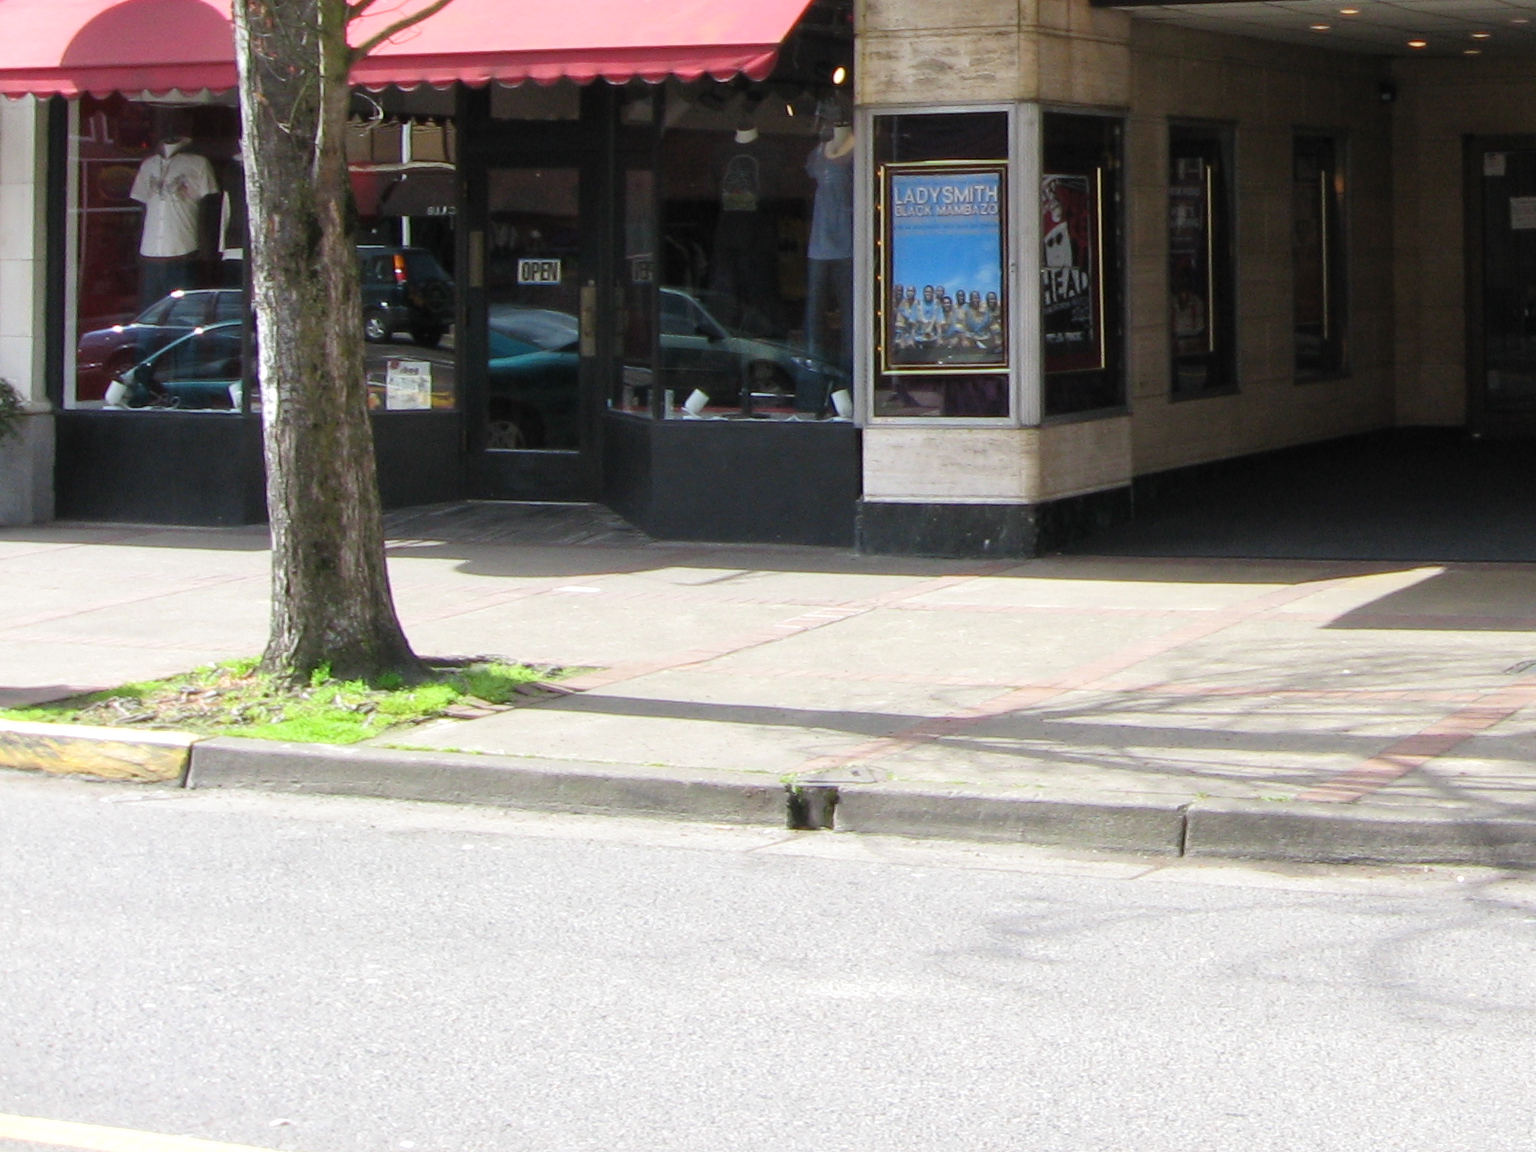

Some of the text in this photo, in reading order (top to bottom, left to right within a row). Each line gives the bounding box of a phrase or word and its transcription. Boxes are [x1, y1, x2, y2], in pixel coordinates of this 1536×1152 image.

[894, 185, 998, 205] LADYSMITH
[895, 203, 998, 217] BLACK MAMBAZO
[521, 261, 558, 282] OPEN
